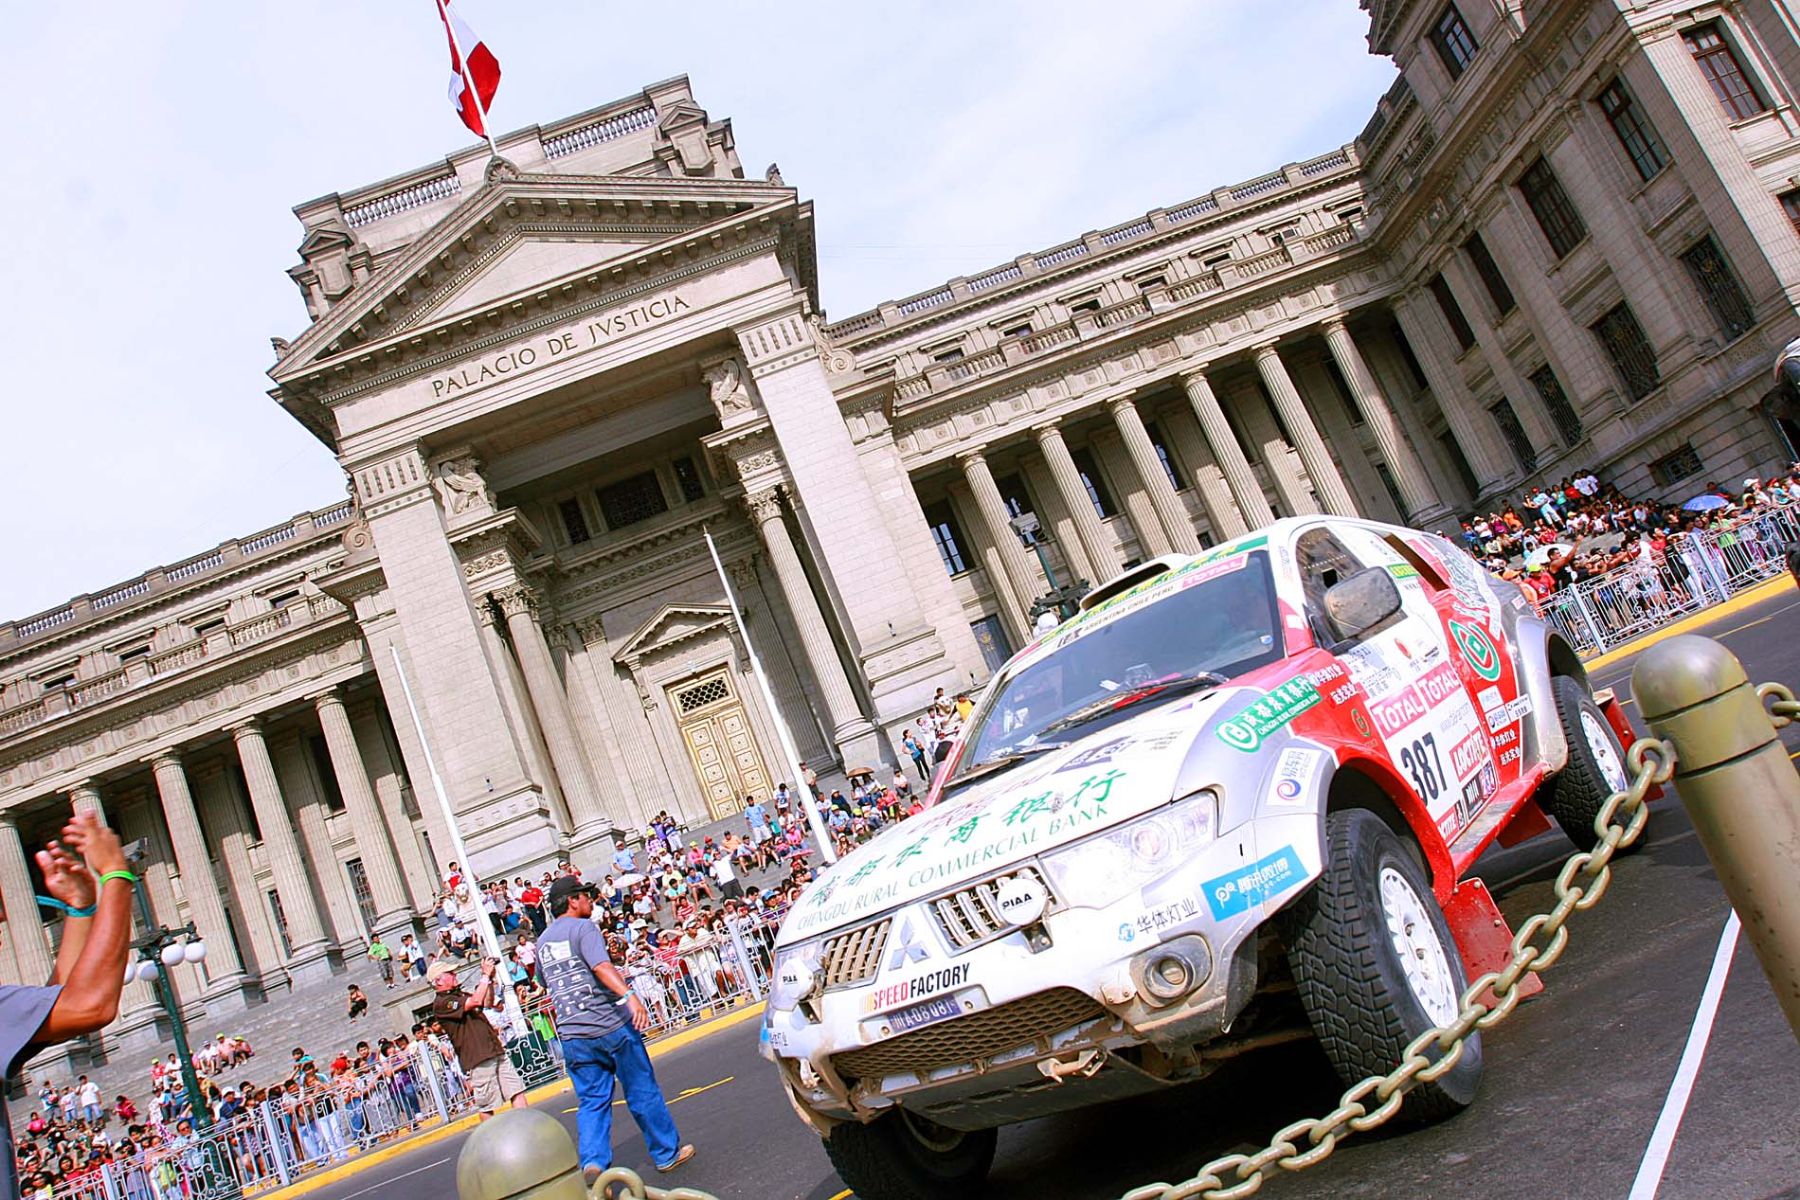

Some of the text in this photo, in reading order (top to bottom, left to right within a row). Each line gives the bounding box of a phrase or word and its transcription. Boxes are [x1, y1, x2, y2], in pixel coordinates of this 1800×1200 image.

[432, 295, 691, 397] PALACIO DE JVSTICIA
[1186, 557, 1244, 584] TOTAL
[1373, 693, 1425, 731] TOTAL
[1420, 671, 1461, 704] TOTAL
[1400, 731, 1448, 807] 387
[854, 879, 900, 914] RURAL
[908, 829, 1039, 888] COMMERCIAL
[1049, 806, 1108, 834] BANK
[1002, 892, 1033, 911] PIAA
[1137, 898, 1198, 934] 华体灯业
[783, 975, 798, 986] PIAA
